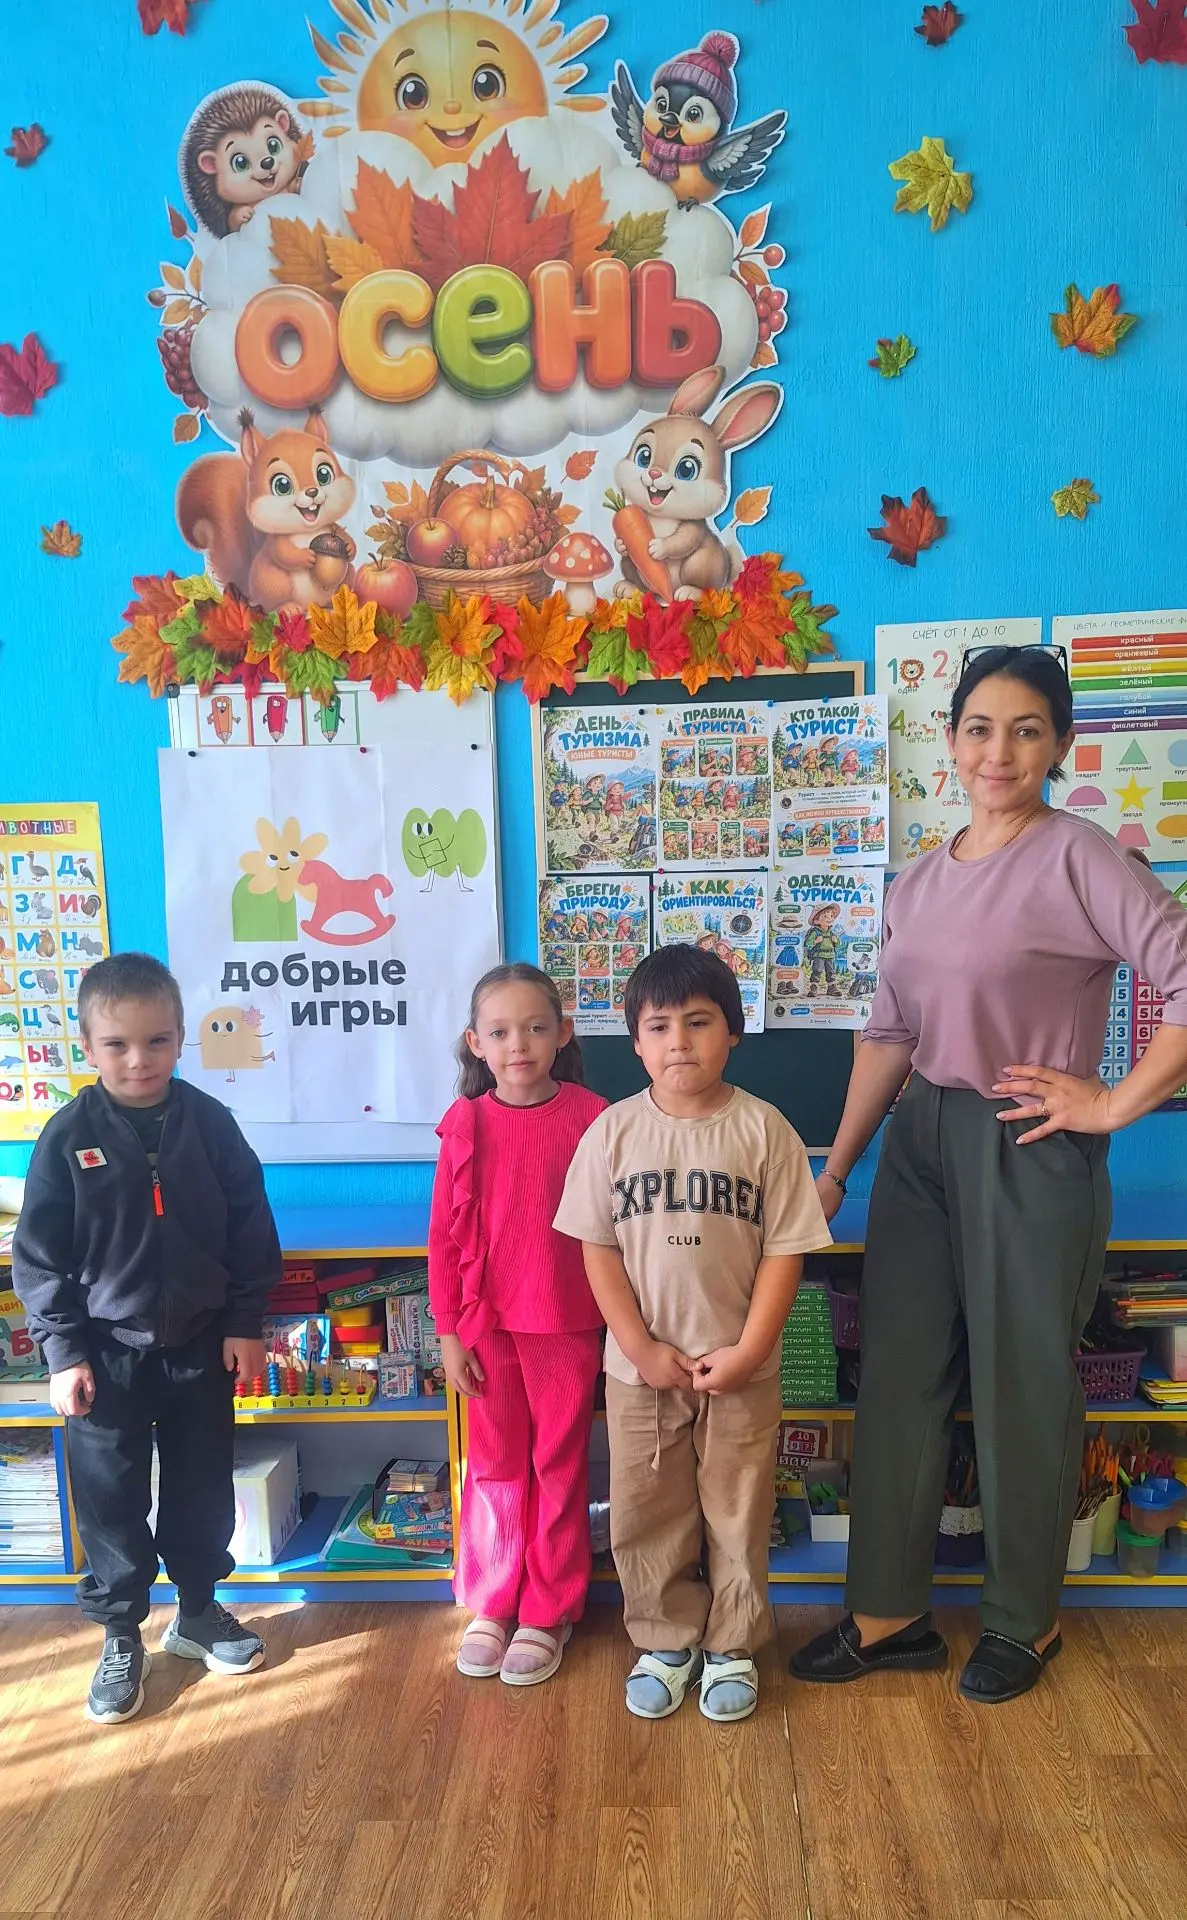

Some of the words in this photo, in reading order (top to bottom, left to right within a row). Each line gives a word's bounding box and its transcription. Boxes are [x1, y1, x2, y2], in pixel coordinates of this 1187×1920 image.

[912, 627, 939, 640] СЧЁТ
[944, 627, 958, 638] ОТ
[971, 626, 988, 640] ДО
[994, 625, 1006, 636] 10
[1120, 635, 1154, 645] красный
[1114, 648, 1159, 659] оранжевый
[887, 657, 898, 685] 1
[932, 650, 948, 679] 2
[1119, 677, 1153, 686] зелёный
[897, 687, 918, 695] один
[683, 707, 746, 722] ПРАВИЛА
[790, 709, 815, 723] КТО
[818, 703, 860, 718] ТАКОЙ
[1123, 707, 1147, 715] синий
[574, 715, 623, 734] ДЕНЬ
[681, 721, 748, 736] ТУРИСТА
[786, 718, 866, 741] ТУРИСТ?
[888, 709, 905, 737] 4
[1111, 720, 1159, 731] фиолетовый
[559, 732, 642, 751] ТУРИЗМА
[570, 750, 596, 760] ЮНЫЕ
[598, 749, 634, 759] ТУРИСТЫ
[932, 771, 948, 797] 7
[908, 822, 923, 849] 9
[11, 855, 24, 876] Г
[57, 855, 77, 877] Д
[690, 879, 731, 896] КАК
[787, 874, 856, 889] ОДЕЖДА
[565, 883, 621, 897] БЕРЕГИ
[790, 888, 862, 904] ТУРИСТА
[15, 893, 30, 913] З
[59, 893, 78, 914] И
[559, 893, 631, 912] ПРИРОДУ
[661, 895, 764, 911] ОРИЕНТИРОВАТЬСЯ?
[16, 932, 40, 952] М
[61, 931, 78, 951] Н
[19, 969, 36, 990] С
[63, 969, 79, 989] Т
[221, 952, 407, 993] добрые
[1117, 969, 1127, 980] 6
[1117, 988, 1127, 1000] 5
[1139, 988, 1150, 1000] 4
[22, 1007, 42, 1029] Ц
[291, 998, 408, 1033] игры
[1116, 1007, 1127, 1019] 4
[1139, 1007, 1149, 1019] 5
[1153, 1007, 1163, 1019] 4
[1116, 1026, 1126, 1038] 3
[1139, 1026, 1149, 1038] 6
[27, 1044, 49, 1064] Ы
[1116, 1046, 1125, 1058] 2
[1139, 1046, 1148, 1057] 7
[1101, 1065, 1111, 1077] 7
[1116, 1065, 1124, 1077] 1
[33, 1081, 49, 1100] Я
[667, 1235, 702, 1246] CLUB
[11, 1327, 35, 1357] Б
[25, 1355, 36, 1364] 33
[238, 1401, 243, 1409] 8
[255, 1400, 260, 1408] 7
[272, 1400, 277, 1408] 6
[306, 1399, 312, 1407] 4
[324, 1398, 329, 1406] 3
[341, 1398, 346, 1406] 2
[797, 1432, 809, 1440] 10
[791, 1458, 797, 1466] 6
